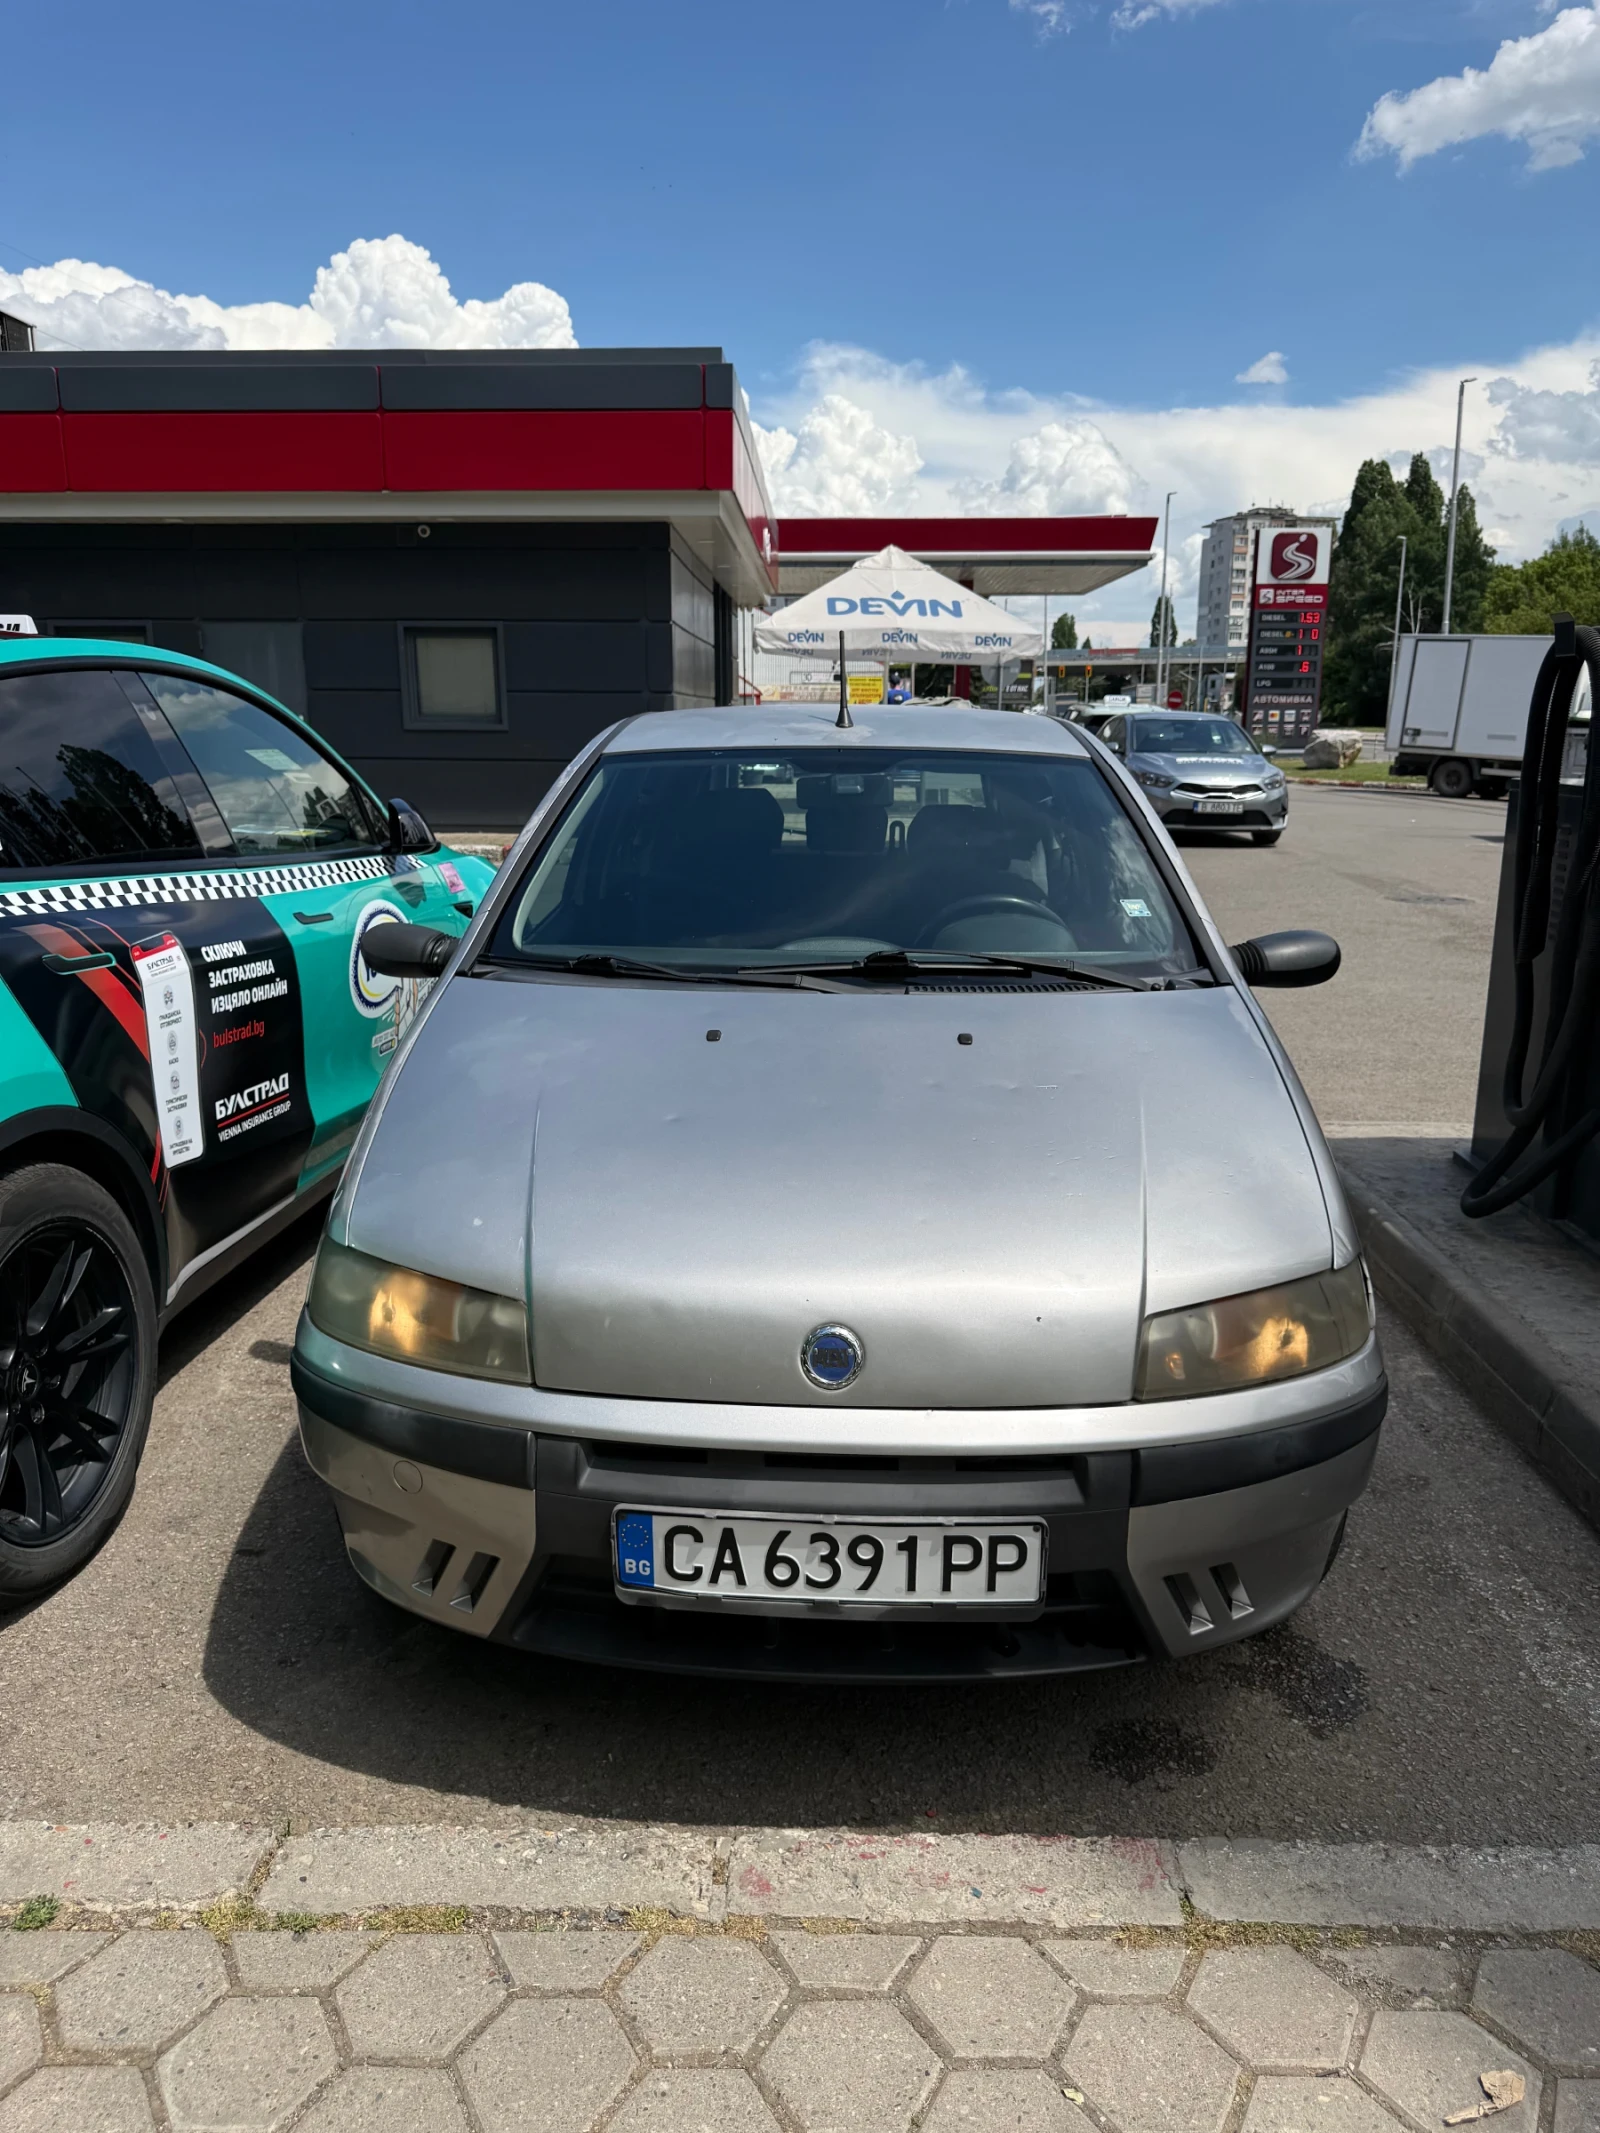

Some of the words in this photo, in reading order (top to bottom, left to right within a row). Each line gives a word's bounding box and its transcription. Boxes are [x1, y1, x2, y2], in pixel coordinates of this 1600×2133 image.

[827, 594, 963, 618] DEVIN
[1275, 595, 1323, 604] SPEED
[788, 631, 824, 643] DEVIN
[882, 631, 918, 643] DEVIN
[975, 634, 1012, 647] DEVIN
[1253, 694, 1313, 704] АВТОМИВКА
[201, 940, 247, 962] СКЛЮЧИ
[208, 959, 275, 988] ЗАСТРАХОВКА
[211, 989, 251, 1014] ИЗЦЯЛО
[251, 978, 288, 1003] ОНЛАЙН
[213, 1020, 264, 1048] bulstrad.bg
[215, 1072, 289, 1120] БУЛСТРАД
[218, 1124, 242, 1143] VIENNA
[241, 1108, 274, 1132] INSURANCE
[273, 1100, 291, 1117] GROUP
[624, 1560, 651, 1576] BG
[664, 1525, 748, 1586] CA
[764, 1530, 919, 1592] 6391
[940, 1534, 1029, 1592] PP
